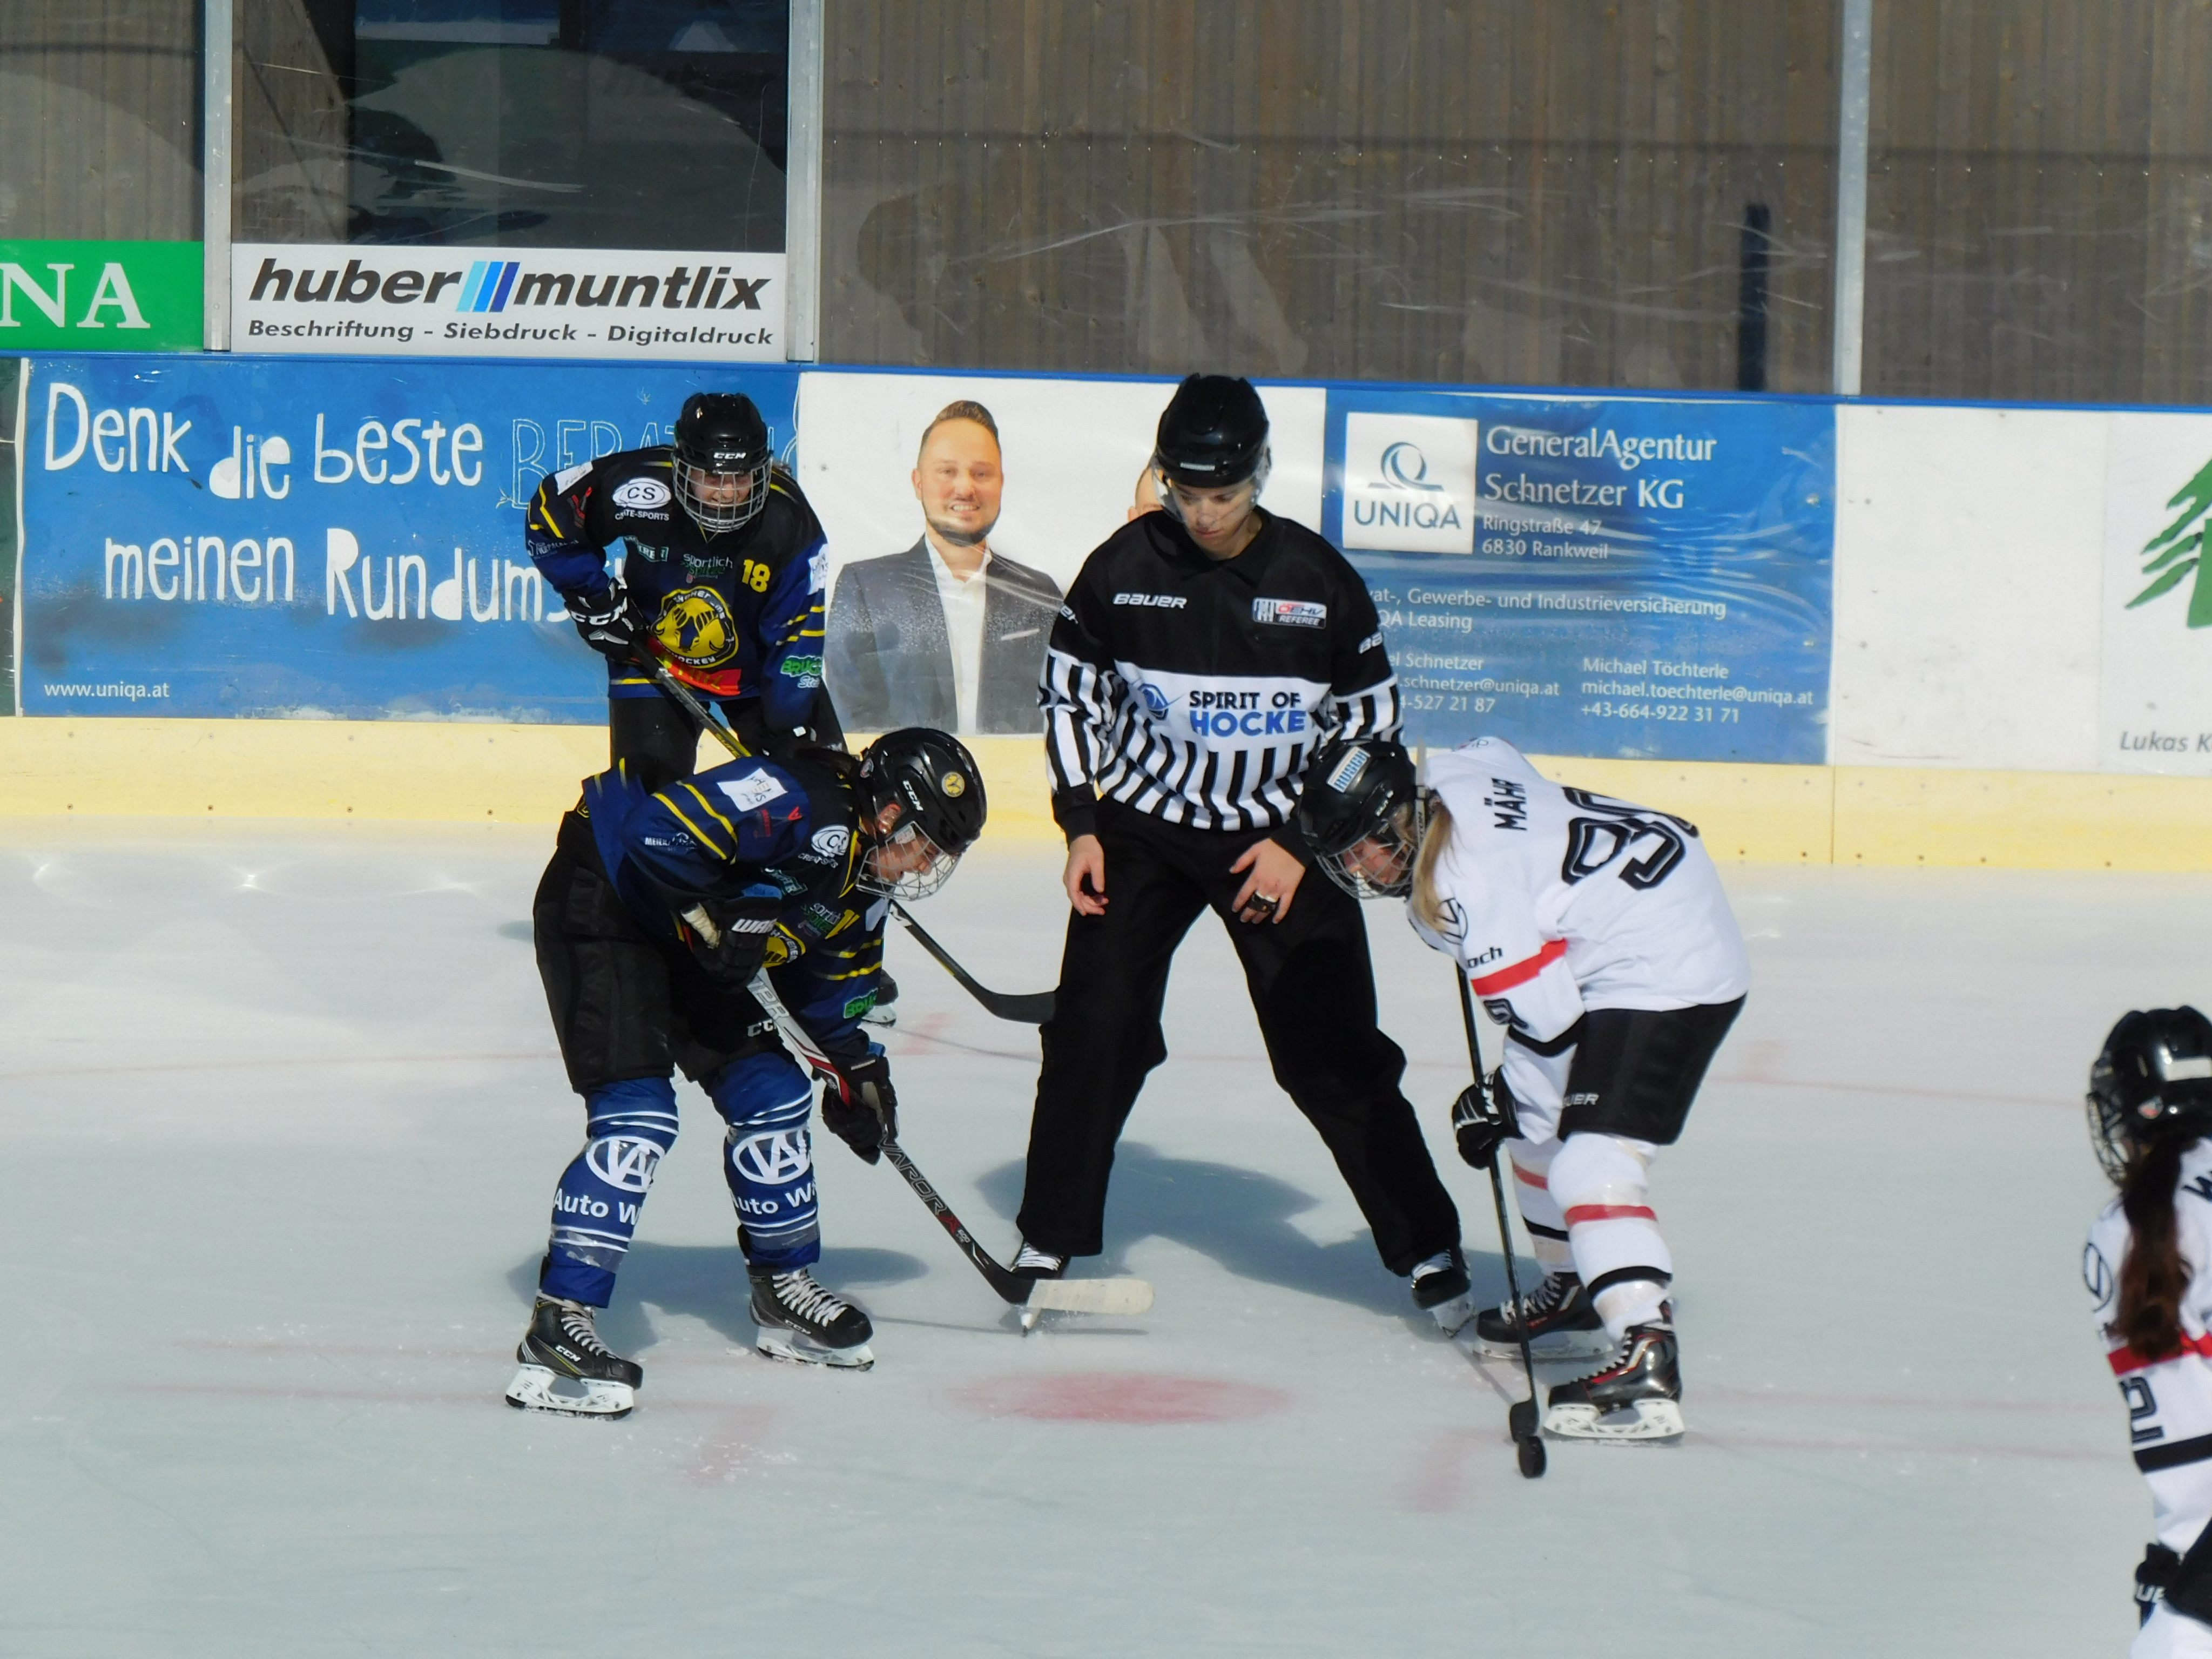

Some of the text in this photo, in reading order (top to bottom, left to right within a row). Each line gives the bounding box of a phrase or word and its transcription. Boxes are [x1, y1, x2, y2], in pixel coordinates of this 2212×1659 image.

[248, 258, 772, 311] huber muntlix
[248, 320, 414, 342] Beschriftung
[443, 322, 576, 341] Siebdruck
[608, 325, 773, 346] Digitaldruck
[45, 382, 192, 473] Denk
[209, 426, 291, 499] die
[314, 413, 483, 486] beste
[1486, 425, 1717, 471] GeneralAgentur
[713, 451, 747, 460] CCM
[627, 487, 656, 500] CS
[1484, 473, 1684, 509] Schnetzer KG
[1354, 500, 1462, 530] UNIQA
[1482, 515, 1602, 536] Ringstraße 47
[1482, 539, 1609, 559] 6830 Rankweil
[105, 536, 294, 602] meinen
[742, 558, 771, 593] 18
[1112, 592, 1188, 609] BAUER
[1408, 588, 1492, 607] Gewerbe-
[1498, 593, 1533, 609] und
[1538, 593, 1727, 621] Industrieversicherung
[1279, 615, 1320, 626] REFEREE
[1408, 611, 1474, 634] Leasing
[1405, 651, 1485, 671] Schnetzer
[1583, 657, 1730, 679] Michael Töchterle
[44, 681, 170, 702] www.uniqa.at
[1189, 691, 1301, 710] SPIRIT OF
[1581, 679, 1813, 707] michael.toechterle@uniqa.at
[1449, 696, 1468, 712] 21
[1474, 698, 1496, 713] 87
[1581, 702, 1739, 724] +43-664-922 31 71
[2120, 730, 2212, 753] Lukas K
[902, 779, 924, 811] CCM
[1483, 777, 1527, 832] MÄHR
[553, 1188, 609, 1218] Auto
[784, 1318, 811, 1336] CCM
[555, 1344, 581, 1363] CCM
